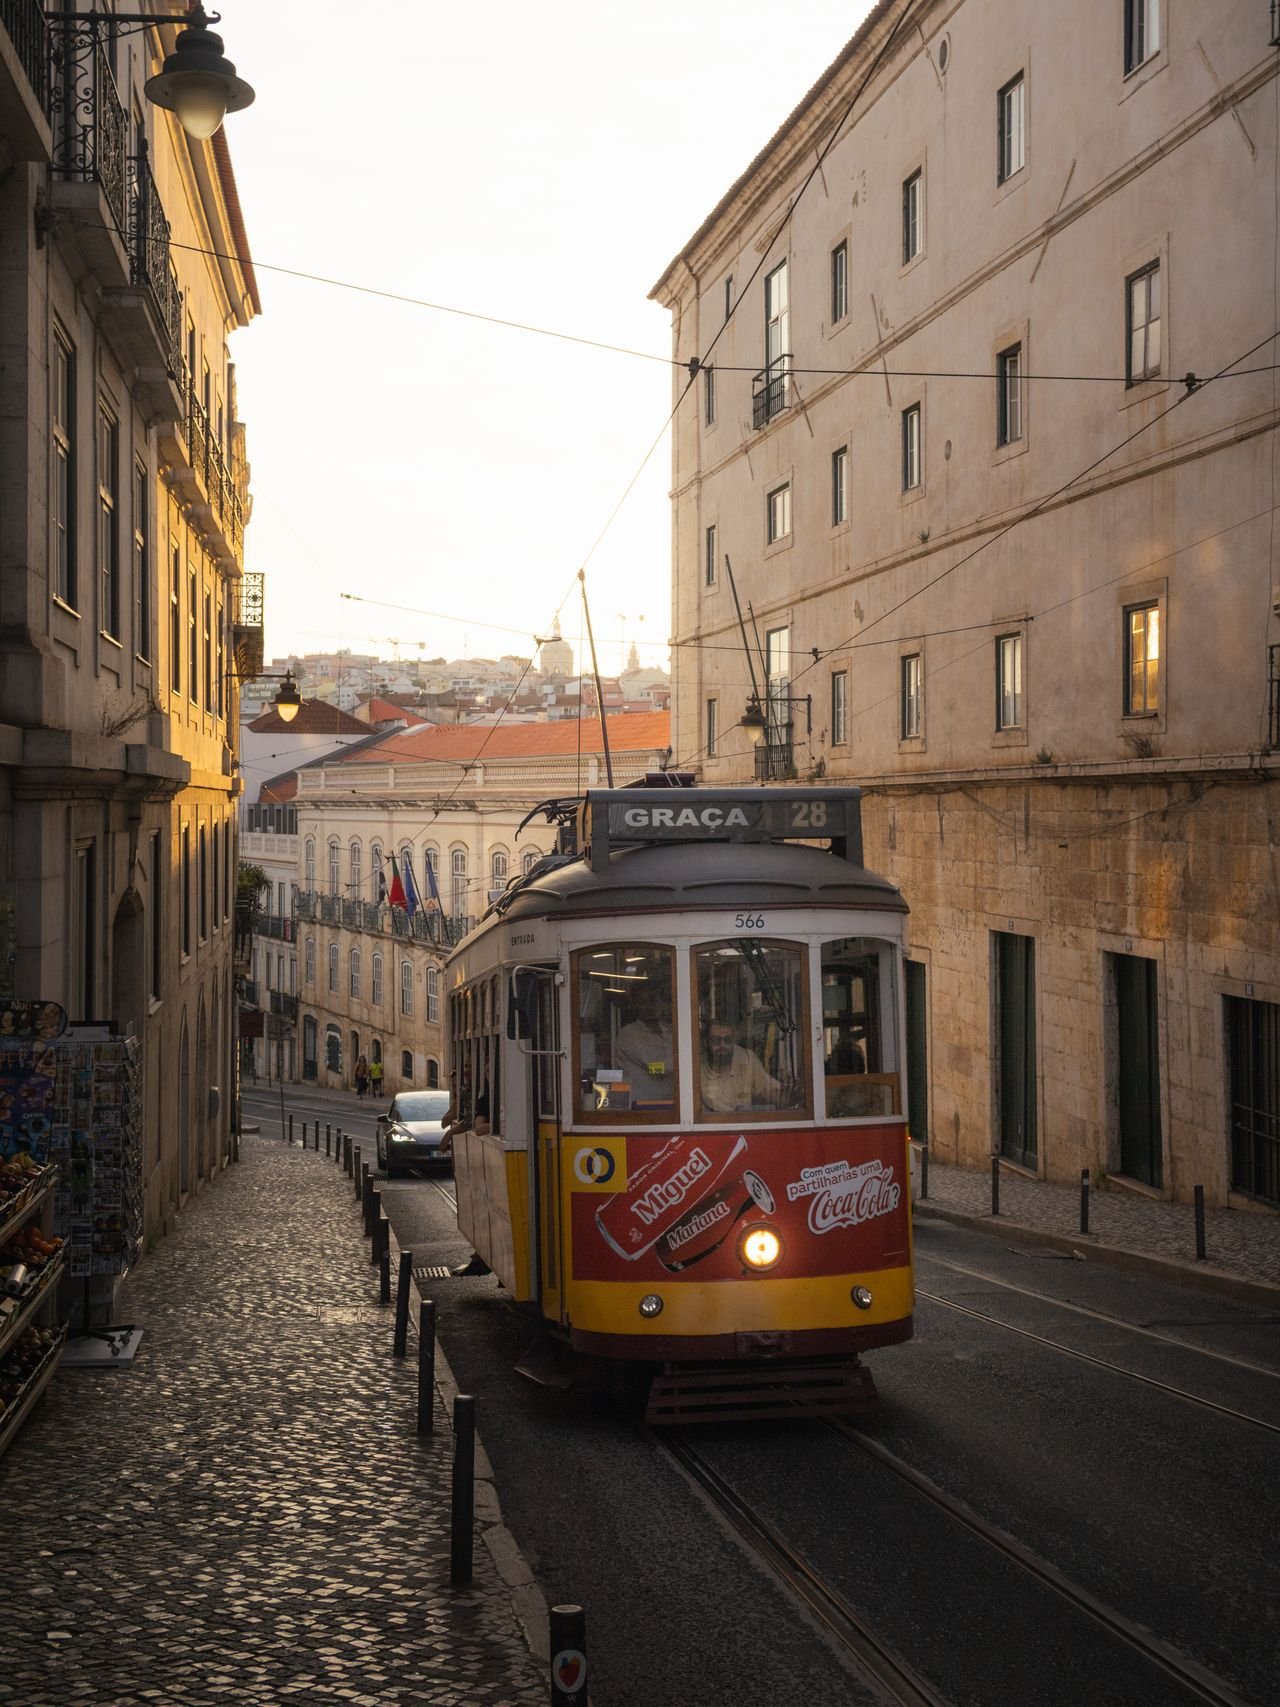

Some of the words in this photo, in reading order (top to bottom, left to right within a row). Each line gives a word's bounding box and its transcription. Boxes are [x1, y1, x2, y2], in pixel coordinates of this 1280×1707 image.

[624, 807, 749, 833] GRAÇA
[791, 800, 828, 828] 28
[734, 913, 765, 929] 566
[511, 933, 535, 947] ENTRADA
[628, 1173, 649, 1192] SABOR
[647, 1150, 675, 1175] ORIGINAL
[789, 1168, 858, 1198] partilharias
[860, 1161, 881, 1176] uma
[803, 1168, 823, 1179] Com
[824, 1163, 848, 1176] quem
[631, 1147, 712, 1224] Miguel
[667, 1202, 730, 1250] Mariana
